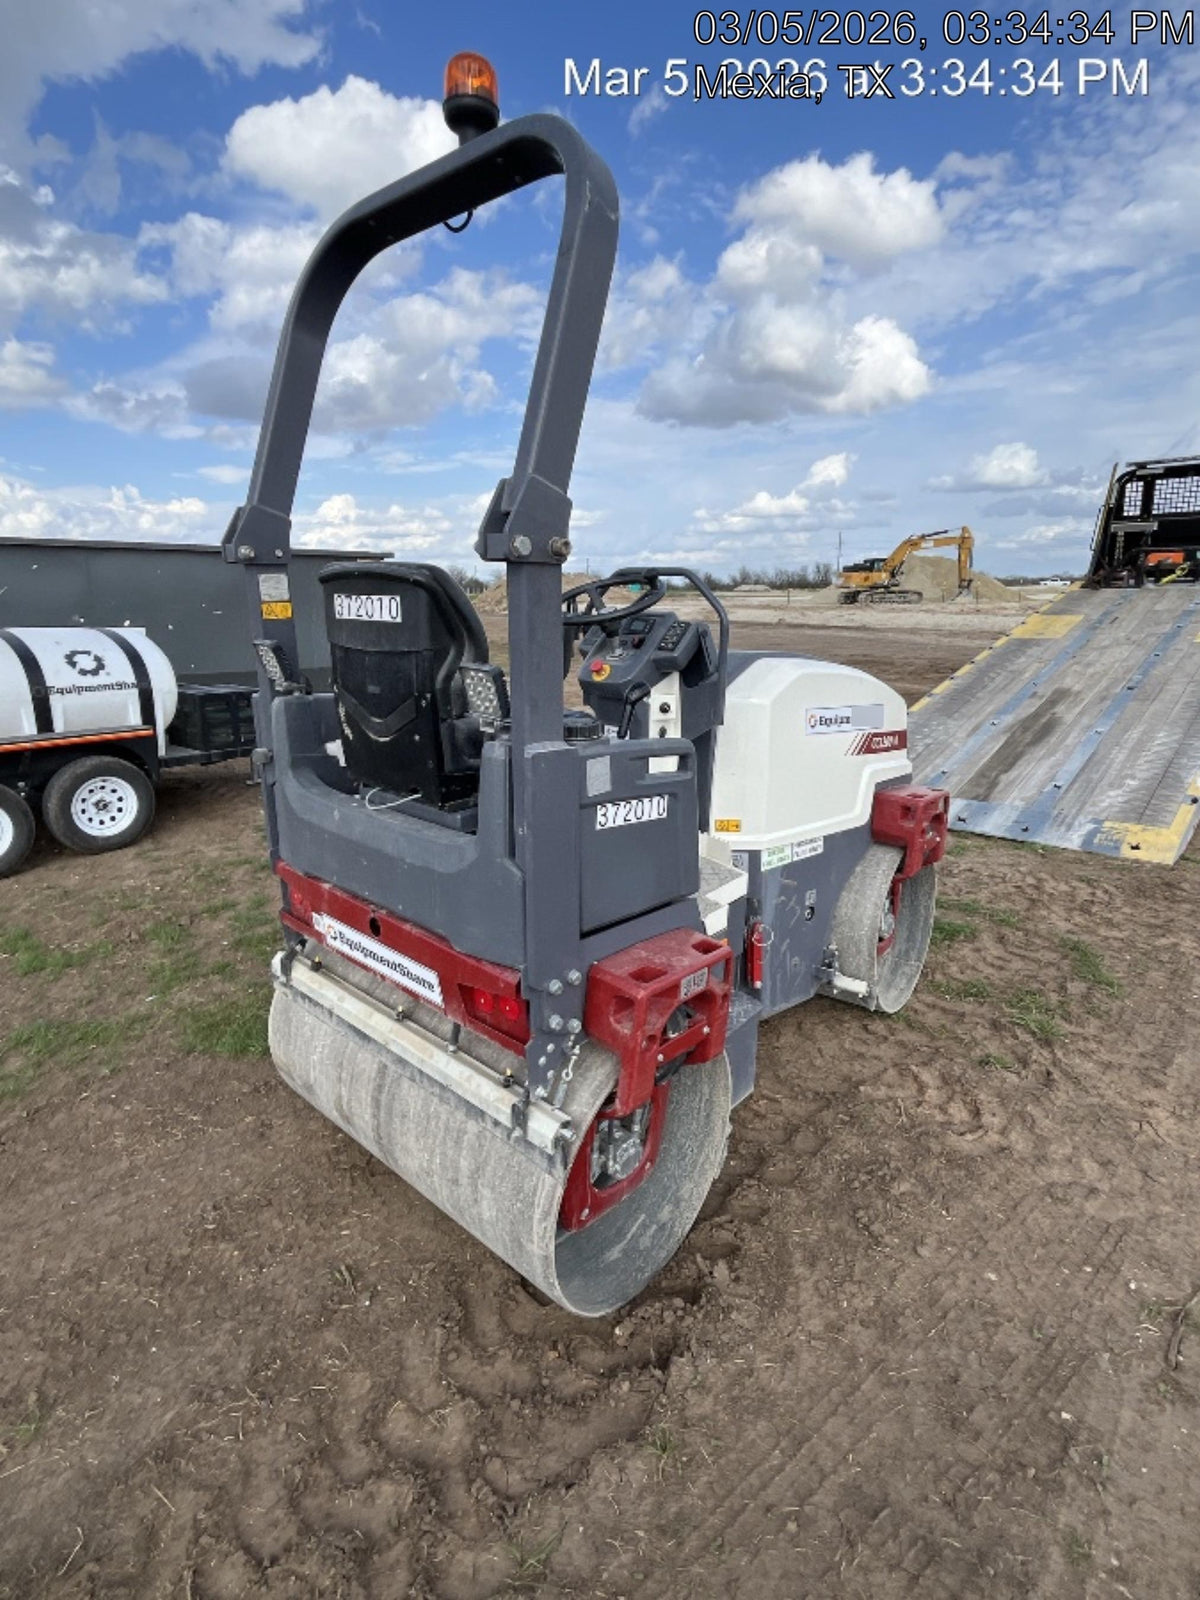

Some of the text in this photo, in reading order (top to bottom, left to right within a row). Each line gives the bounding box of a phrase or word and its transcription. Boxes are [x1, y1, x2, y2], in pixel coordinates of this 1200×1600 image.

[335, 594, 400, 620] 372010
[598, 795, 666, 827] 372010
[337, 930, 436, 993] EquipmentShare
